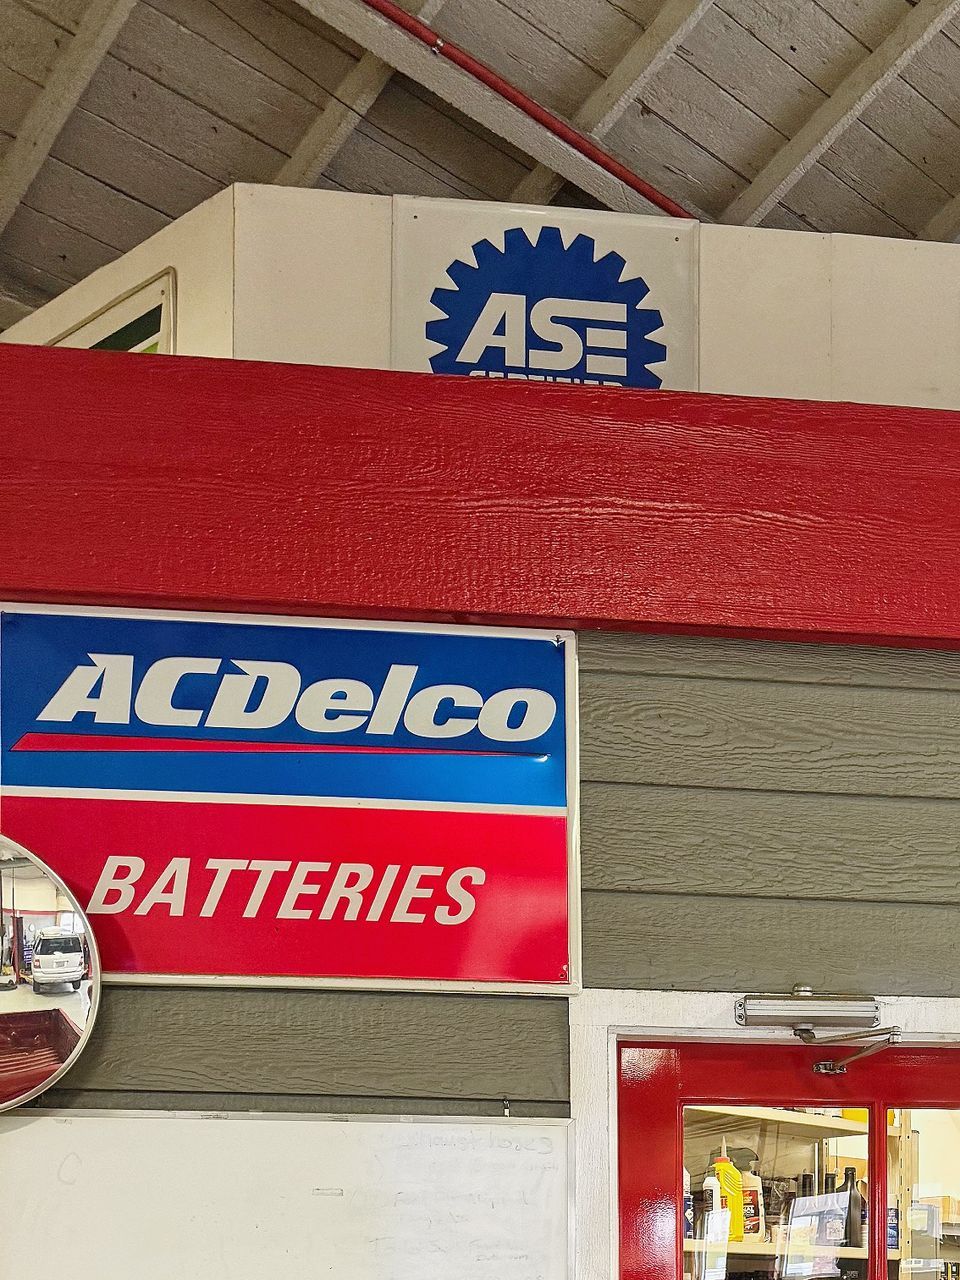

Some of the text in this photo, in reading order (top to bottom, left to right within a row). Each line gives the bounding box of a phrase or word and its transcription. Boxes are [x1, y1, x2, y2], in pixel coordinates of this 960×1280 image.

[455, 293, 627, 377] ASE
[36, 653, 557, 742] ACDelco
[87, 855, 486, 925] BATTERIES
